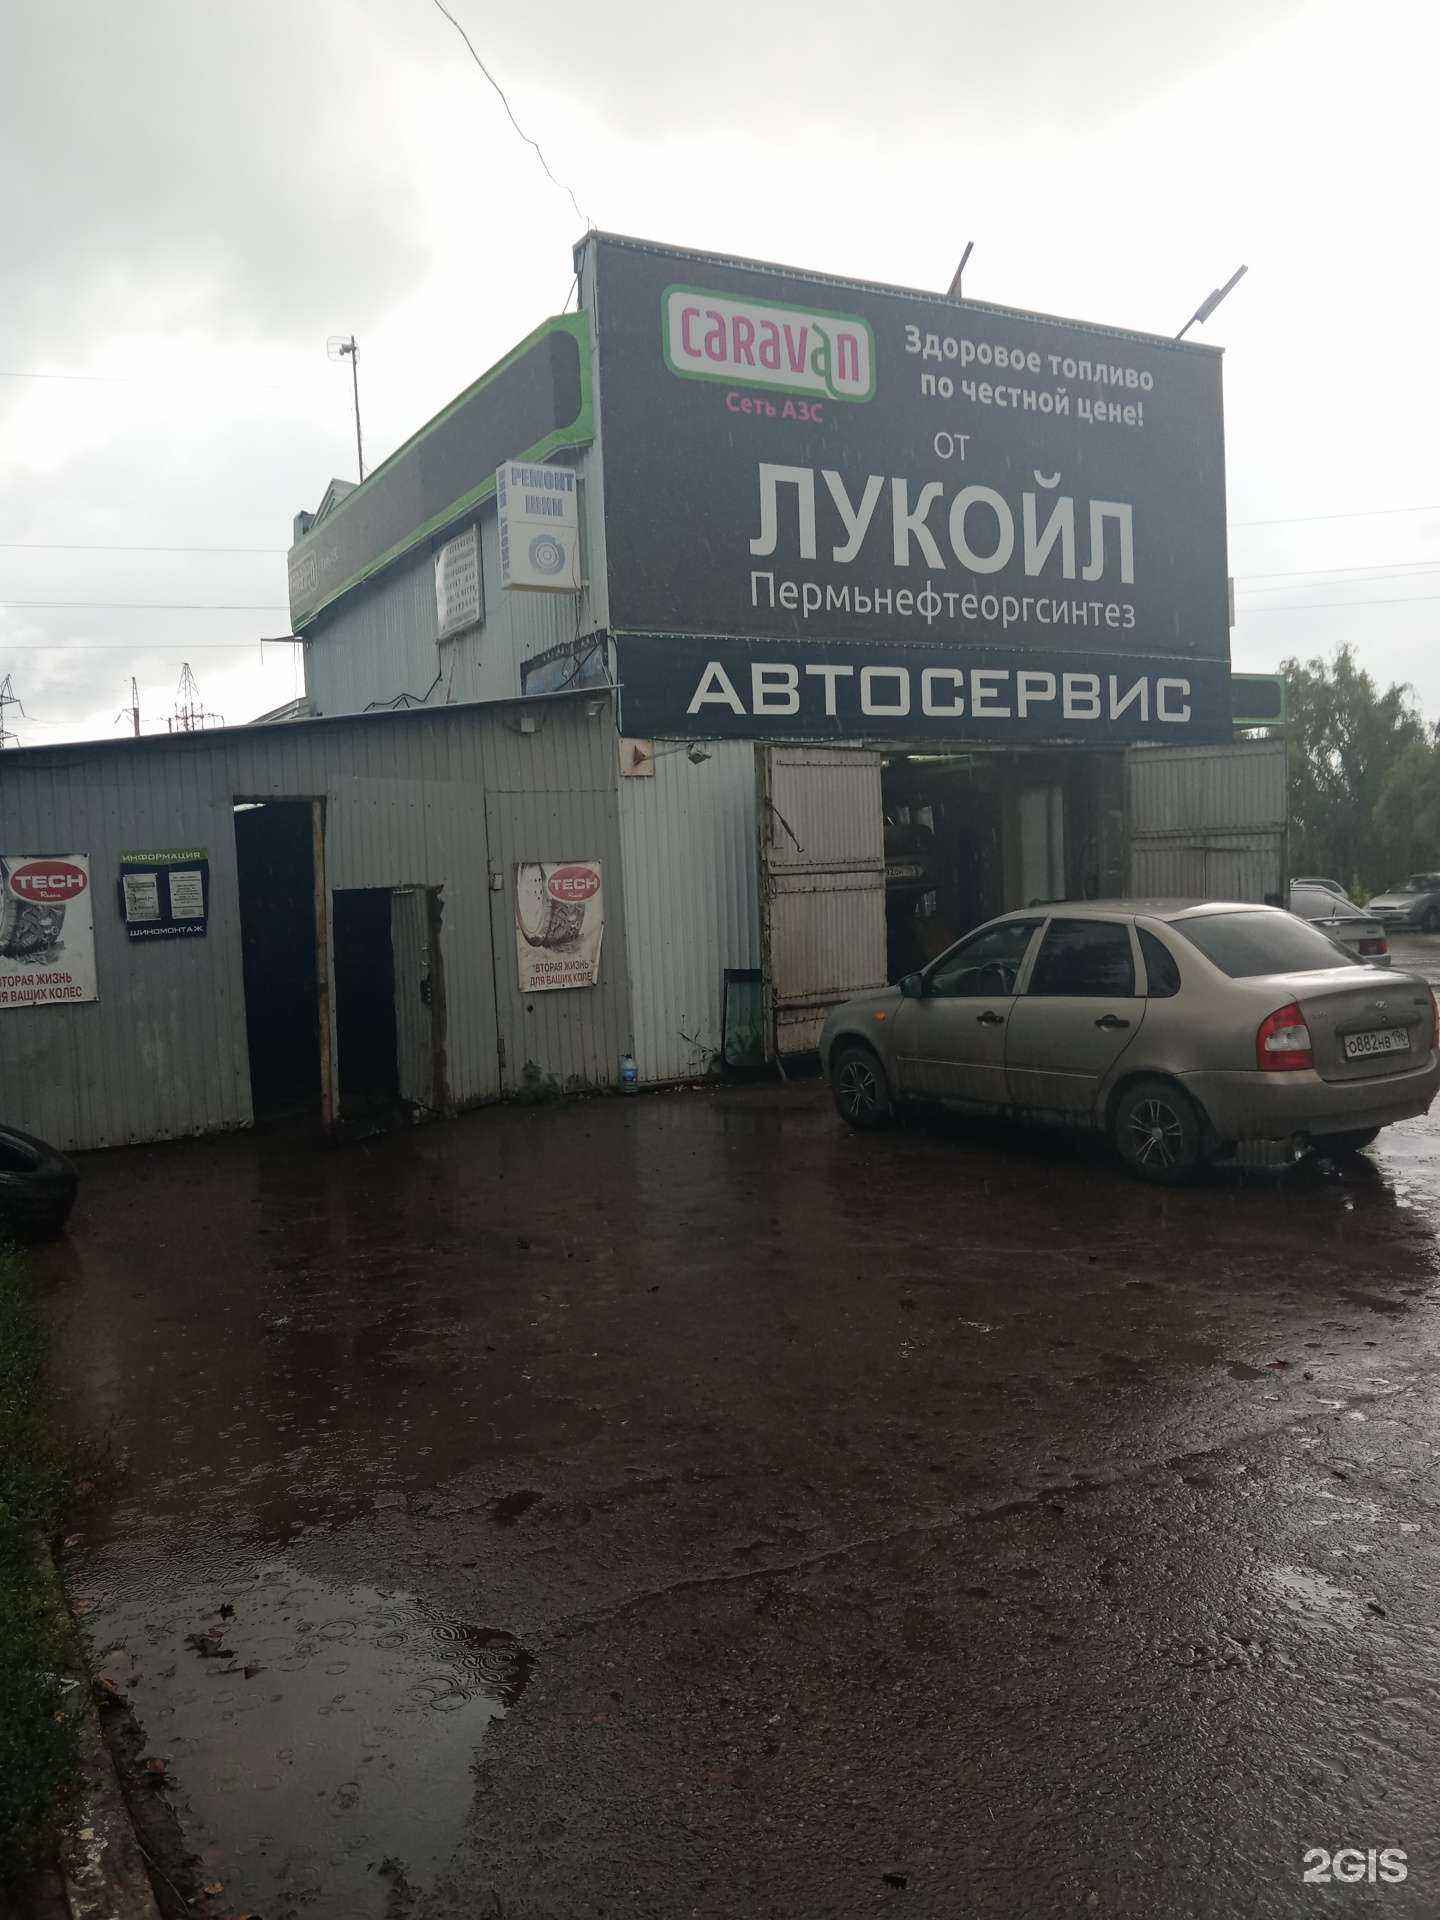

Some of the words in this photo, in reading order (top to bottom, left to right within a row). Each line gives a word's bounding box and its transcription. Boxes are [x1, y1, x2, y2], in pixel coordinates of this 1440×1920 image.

[904, 323, 1042, 374] Здоровое
[1047, 353, 1155, 393] топливо
[725, 391, 776, 418] Сеть
[781, 400, 825, 423] АЗС
[920, 372, 954, 399] по
[961, 377, 1071, 417] честной
[1077, 396, 1145, 427] цене!
[511, 467, 575, 492] РЕМОНТ
[749, 462, 1136, 585] ЛУКОЙЛ
[750, 570, 1137, 629] Пермьнефтеоргсинтез
[686, 660, 1193, 723] АВТОСЕРВИС
[122, 851, 201, 861] ИНФОРМАЦИЯ
[15, 874, 84, 889] TECH
[551, 877, 598, 890] TECH
[129, 925, 204, 936] ШИНОМОНТАЖ
[535, 961, 563, 973] ВТОРАЯ
[564, 959, 589, 971] ЖИЗНЬ
[36, 972, 73, 985] ЖИЗНЬ
[11, 988, 47, 1001] ВАШИХ
[49, 986, 82, 999] КОЛЕС
